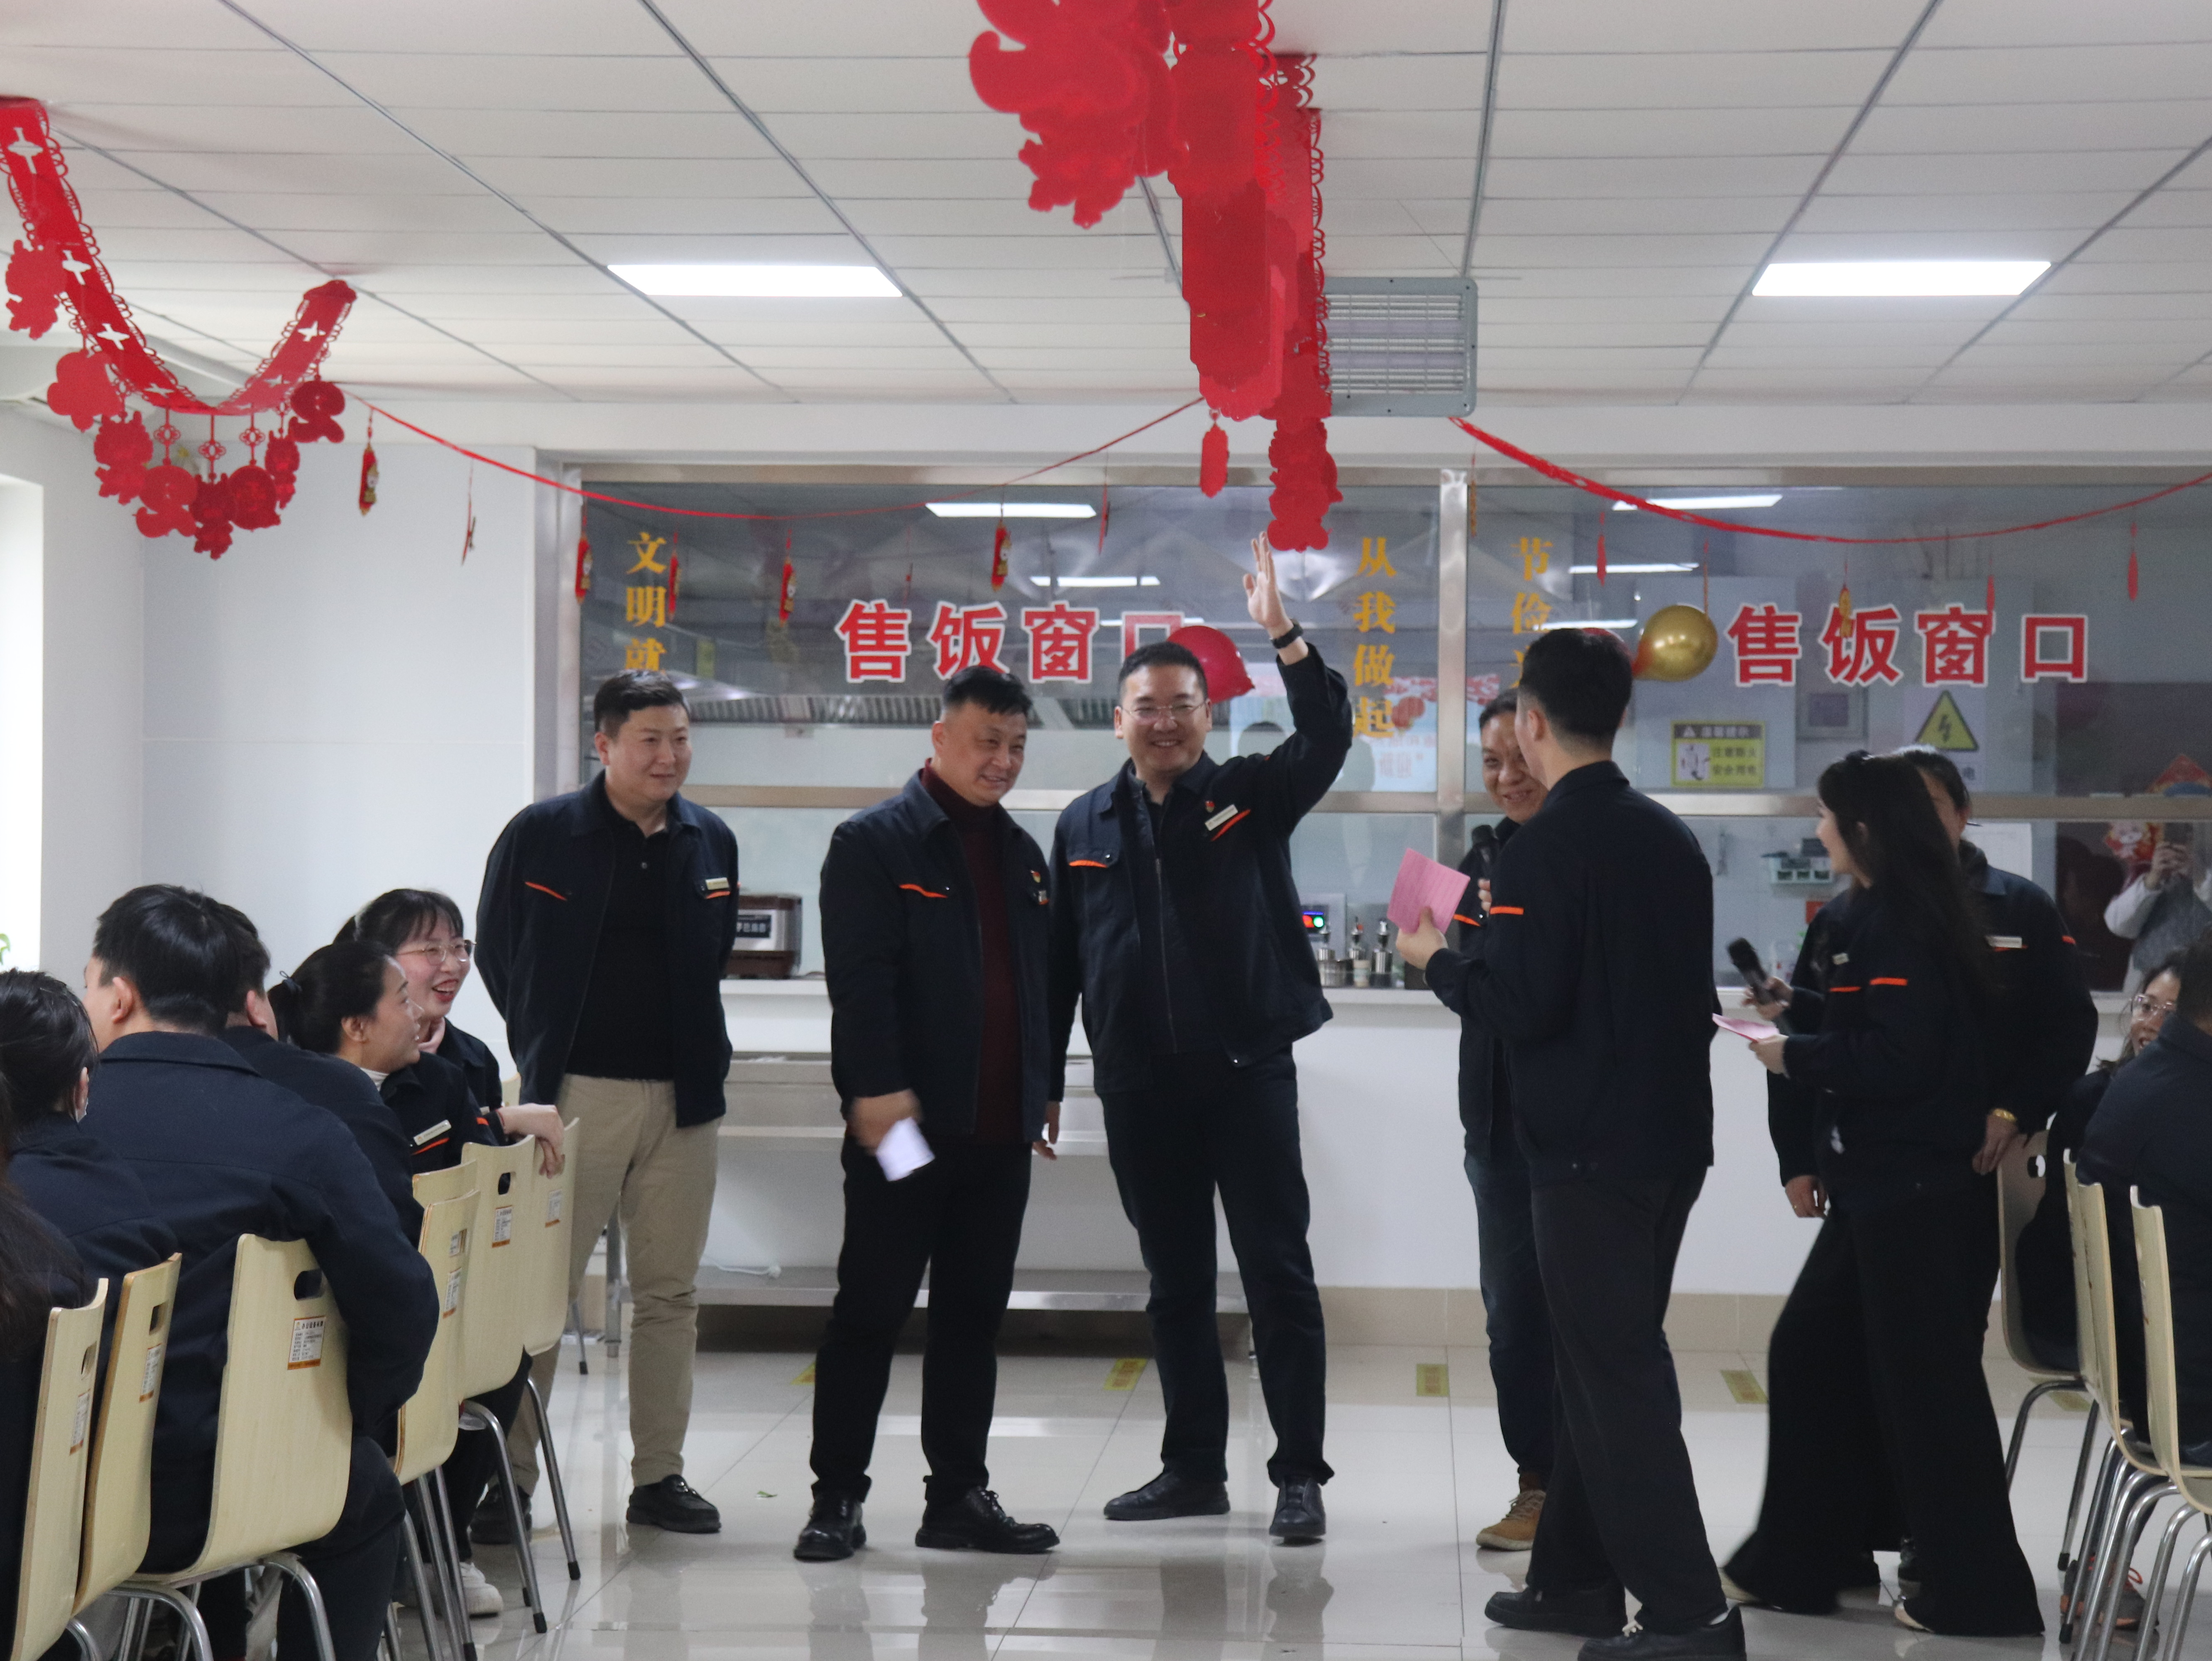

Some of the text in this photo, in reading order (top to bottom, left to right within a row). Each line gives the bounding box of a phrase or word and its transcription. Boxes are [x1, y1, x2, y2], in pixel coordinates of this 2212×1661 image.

[625, 532, 667, 671] 文明就
[835, 599, 1185, 683] 售饭窗口
[1353, 537, 1397, 738] 从我做起
[1510, 537, 1554, 689] 节俭
[1726, 602, 2088, 686] 售饭窗口
